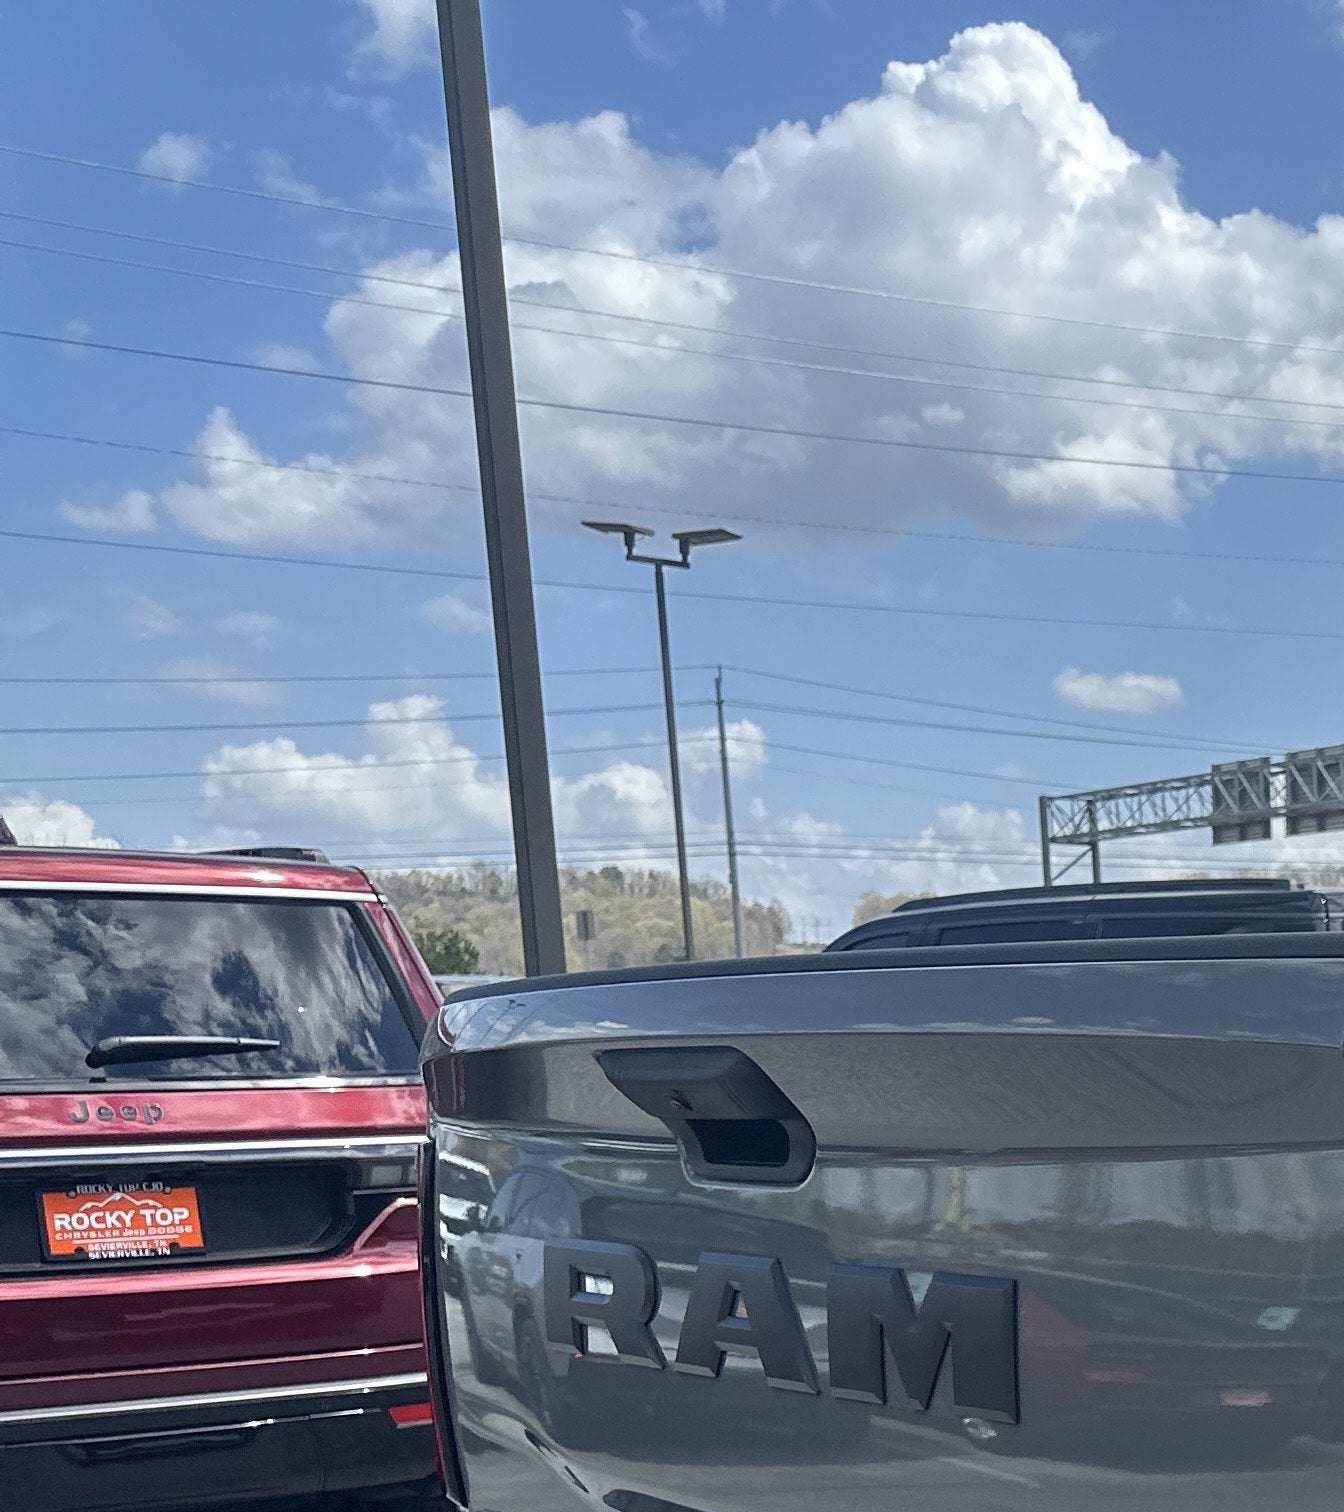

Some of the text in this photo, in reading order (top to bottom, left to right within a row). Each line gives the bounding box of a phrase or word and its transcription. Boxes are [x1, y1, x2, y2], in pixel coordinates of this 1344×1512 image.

[69, 1100, 164, 1125] Jeep
[77, 1183, 113, 1195] ROCKY
[53, 1207, 190, 1231] ROCKY TOP
[55, 1225, 193, 1241] CHRYSLER Jeep DODGE
[544, 1237, 1021, 1425] RAM
